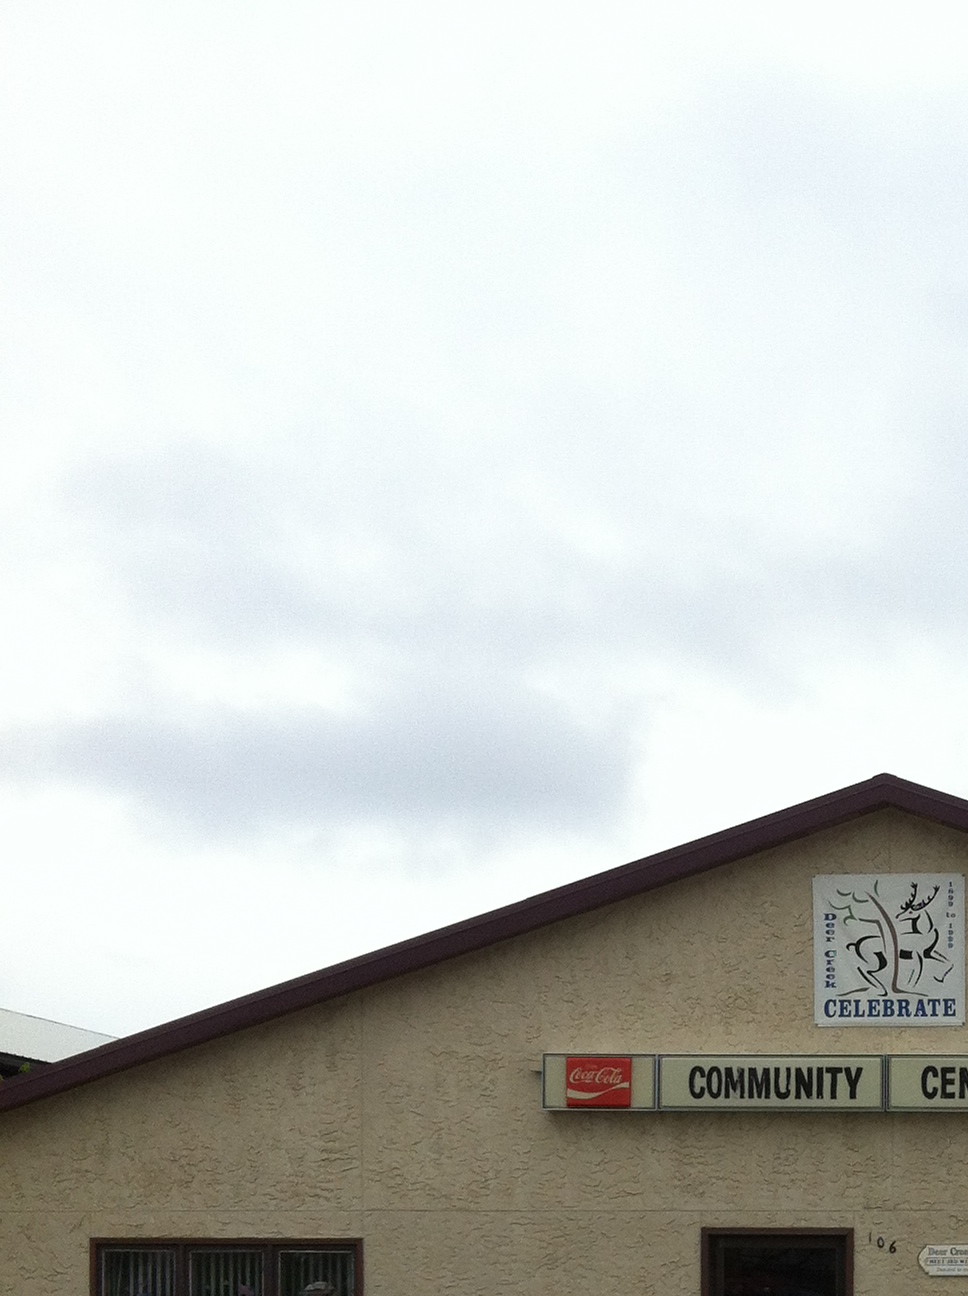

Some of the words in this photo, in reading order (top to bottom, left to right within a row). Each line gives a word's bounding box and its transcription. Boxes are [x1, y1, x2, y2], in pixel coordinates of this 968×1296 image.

[823, 913, 837, 942] Deer
[824, 950, 837, 988] Creek
[824, 998, 956, 1018] CELEBRATE
[569, 1067, 623, 1084] Coca-Cola
[688, 1065, 863, 1100] COMMUNITY
[868, 1231, 897, 1254] 106
[927, 1247, 948, 1256] Deer
